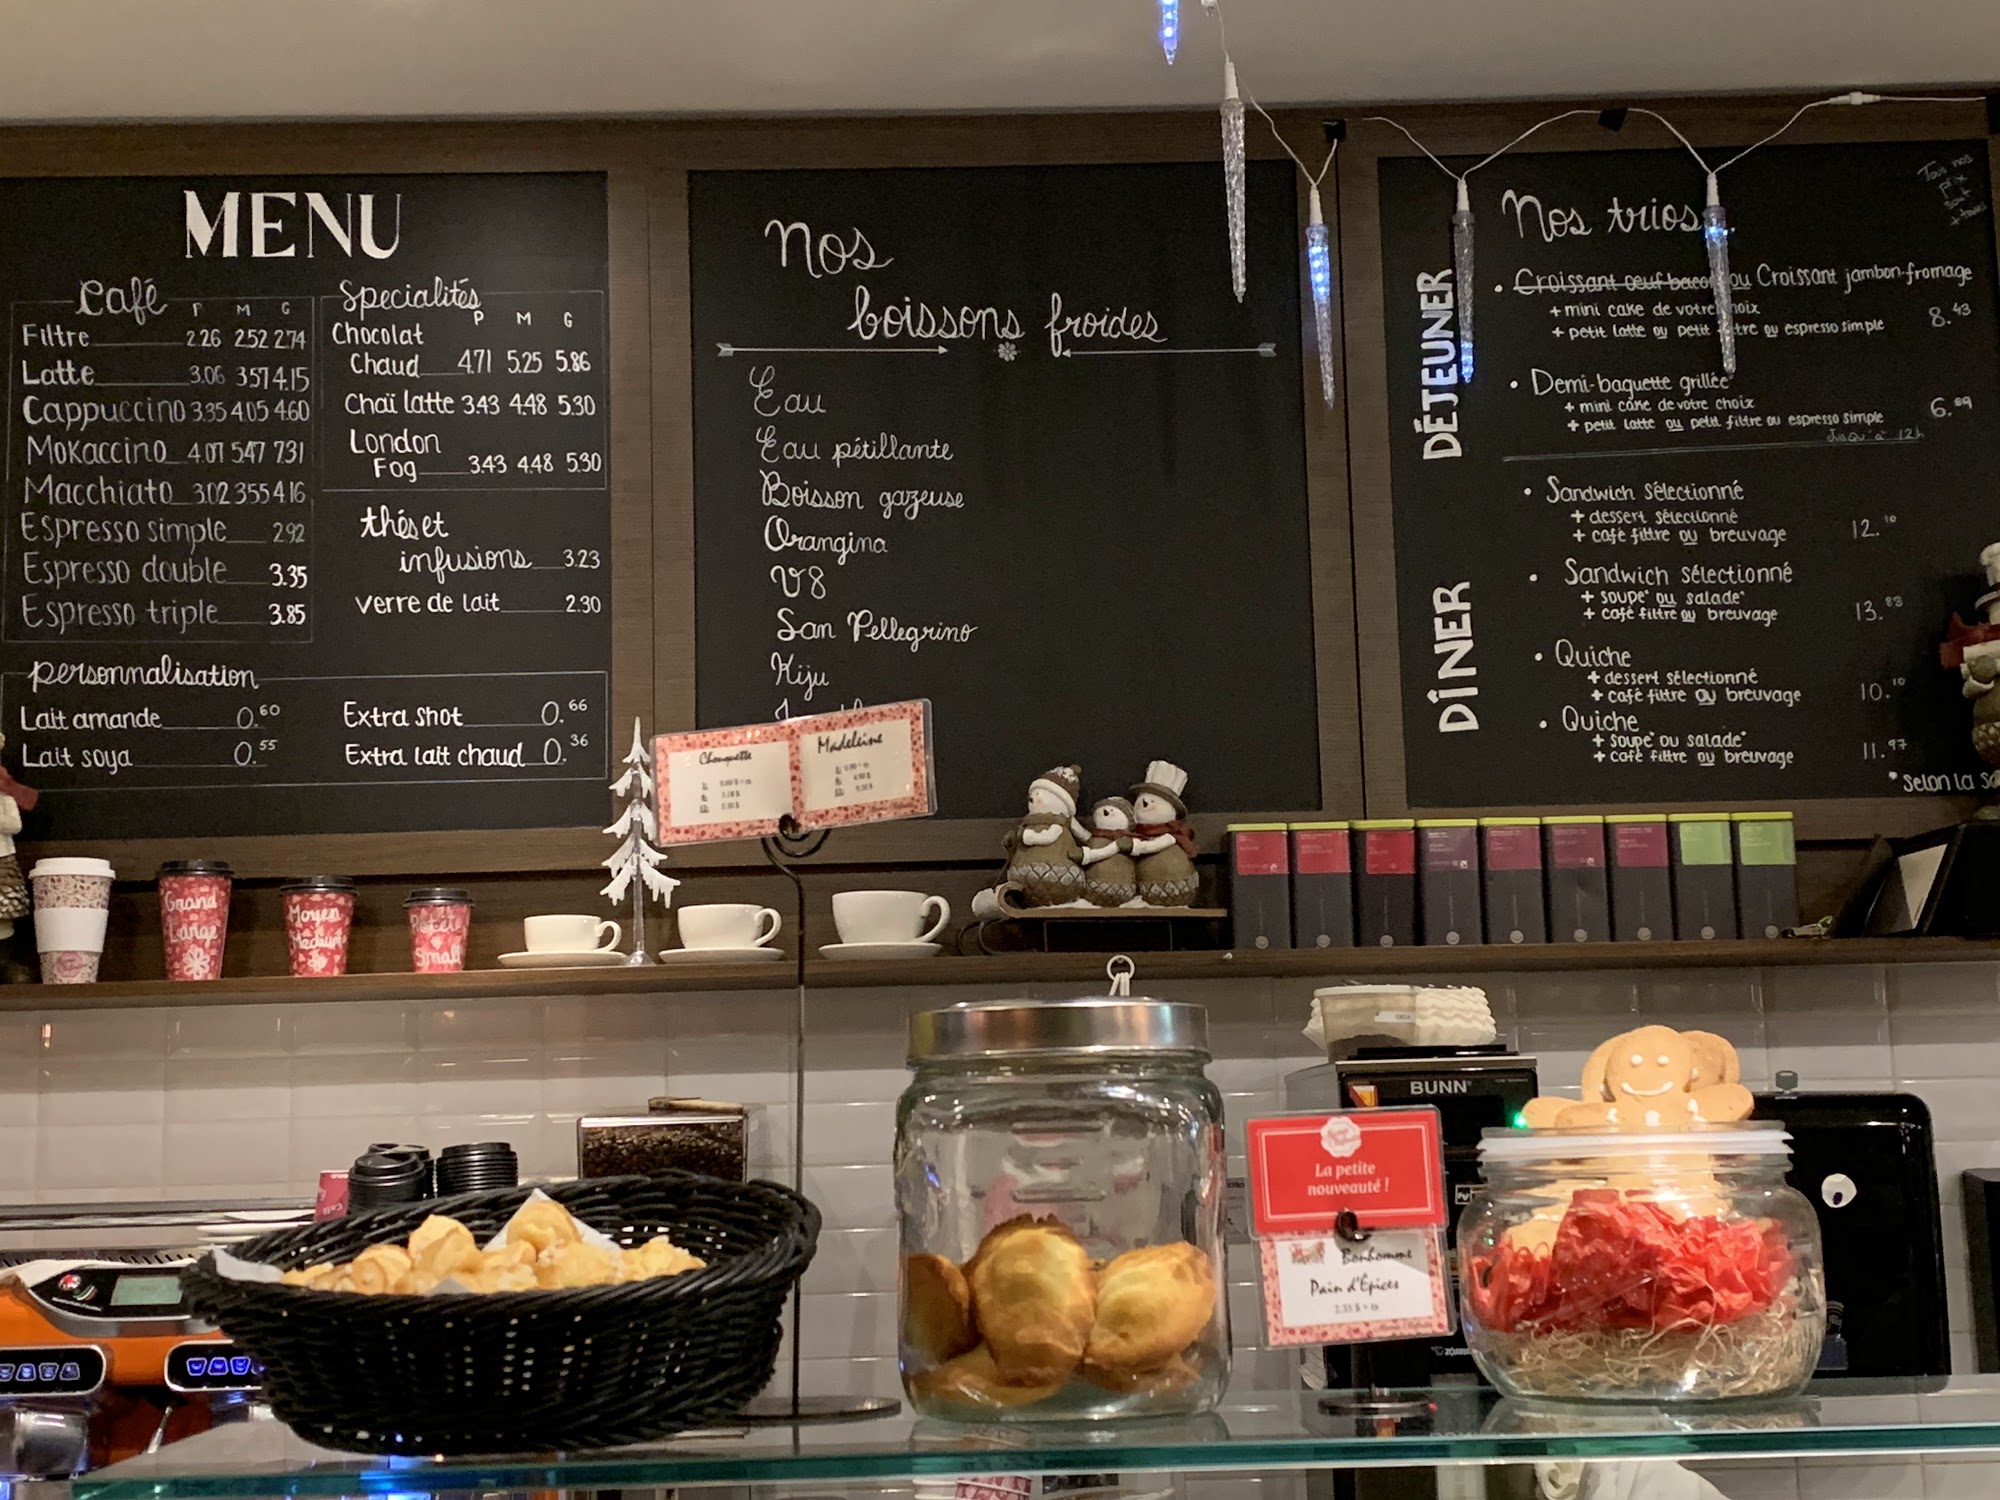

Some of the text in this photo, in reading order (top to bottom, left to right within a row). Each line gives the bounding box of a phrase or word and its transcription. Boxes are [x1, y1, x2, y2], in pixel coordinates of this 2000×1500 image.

[184, 190, 401, 259] MENU
[1502, 189, 1702, 242] Nos trios
[764, 219, 1168, 357] Nos boissons froides
[1757, 263, 1838, 287] Croissant
[76, 277, 168, 326] Café
[1565, 302, 1601, 317] mini
[1607, 303, 1645, 317] cake
[1652, 301, 1672, 316] de
[473, 311, 573, 328] P M G
[1569, 326, 1608, 340] petit
[1613, 324, 1647, 338] latte
[1785, 321, 1838, 338] espresso
[1842, 319, 1885, 332] simple
[22, 324, 90, 347] Filtre
[332, 323, 424, 346] Chocolat
[22, 360, 95, 385] Latte
[272, 366, 310, 392] 4.15
[351, 349, 592, 379] Chaud 4.71 5.25 5.86
[1414, 268, 1462, 460] DÉJEUNER
[749, 365, 826, 417] Eau
[1532, 368, 1729, 400] Demi-baguette grillée
[23, 395, 186, 431] Cappuccino
[344, 389, 597, 416] Chaï latte 3.43 4.48 5.30
[1580, 400, 1612, 413] mini
[1658, 398, 1676, 412] de
[1679, 399, 1709, 410] votre
[1788, 413, 1839, 427] espresso
[1842, 411, 1884, 426] simple
[27, 435, 167, 465] Mokaccino
[350, 429, 441, 454] London
[756, 425, 954, 468] Eau pétillante
[373, 452, 602, 482] Fog 3.43 4.48 5.30
[24, 474, 173, 505] Macchiato
[760, 469, 965, 520] Boisson gazeuse
[1546, 475, 1744, 503] Sandwich sélectionné
[360, 505, 449, 539] thés et
[1589, 509, 1738, 525] dessert sélectionné
[20, 511, 139, 548] Espresso
[148, 518, 227, 554] simple
[764, 515, 888, 565] Orangina
[1591, 528, 1627, 544] café
[1630, 527, 1670, 544] filtre
[1709, 527, 1787, 547] breuvage
[23, 551, 308, 589] Espresso double 3.35
[399, 545, 600, 584] infusions 3.23
[1564, 557, 1793, 586] Sandwich sélectionné
[770, 565, 826, 599] V8
[22, 593, 306, 635] Espresso triple 3.85
[355, 592, 601, 614] verre de lait 2.30
[1601, 605, 1635, 622] café
[1638, 607, 1678, 620] filtre
[1707, 607, 1778, 627] breuvage
[777, 607, 978, 652] San Pellegrino
[1427, 581, 1479, 733] DÎNER
[1555, 639, 1632, 668] Quiche
[27, 654, 259, 693] personnalisation
[771, 651, 829, 701] Kiju
[1604, 668, 1758, 685] dessert sélectionné
[1607, 687, 1802, 707] café filtre breuvage
[20, 706, 68, 730] Lait
[72, 707, 162, 730] amande
[343, 701, 410, 727] Extra
[415, 706, 464, 727] shot
[1562, 705, 1640, 732] Quiche
[345, 743, 408, 766] Extra
[414, 746, 451, 766] lait
[457, 742, 526, 767] chaud
[817, 731, 883, 754] Madeleine
[22, 744, 74, 768] Lait
[82, 748, 133, 775] soya
[1610, 750, 1644, 763] café
[1650, 750, 1688, 763] filtre
[1724, 750, 1794, 769] breuvage
[1903, 774, 1951, 792] Selon
[1954, 773, 1975, 791] la
[1410, 1080, 1467, 1095] BUNN
[1315, 1161, 1376, 1179] La petite
[1308, 1179, 1381, 1196] nouveauté
[1342, 1247, 1412, 1265] Bonhomme
[1310, 1279, 1343, 1297] Pain
